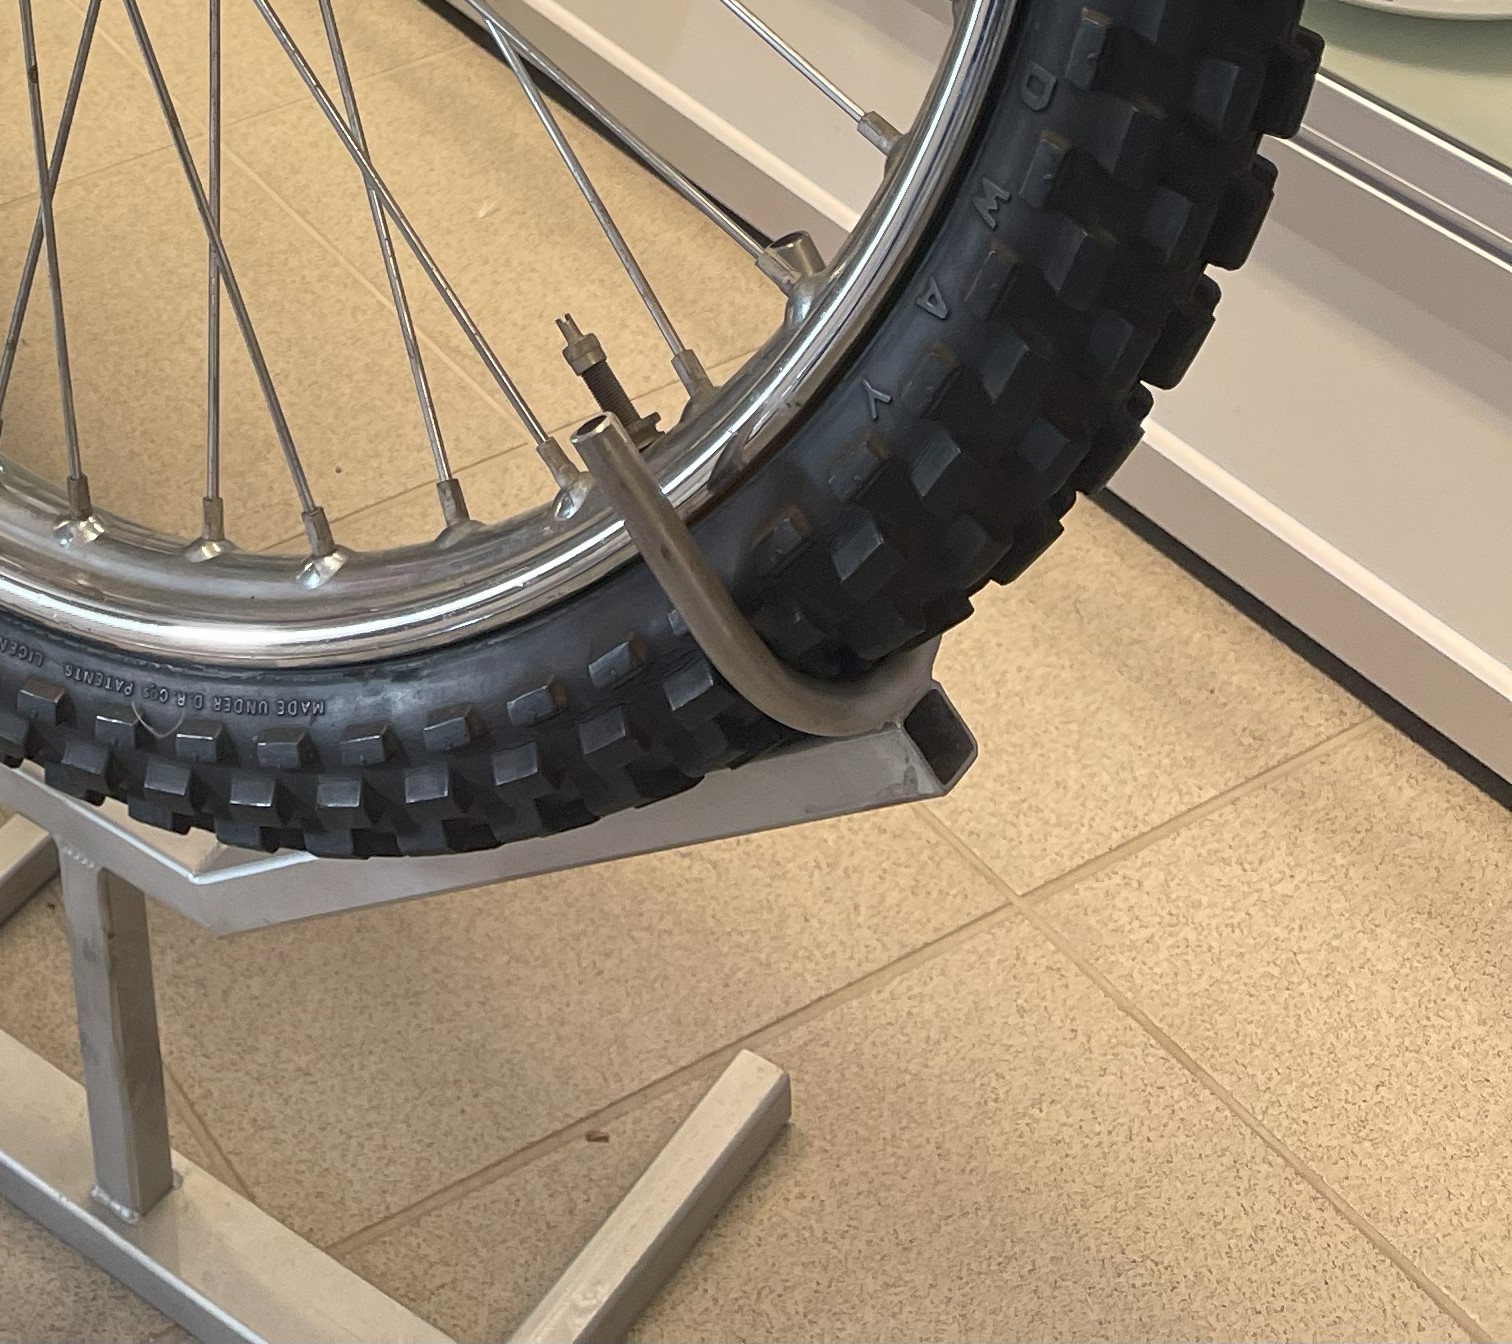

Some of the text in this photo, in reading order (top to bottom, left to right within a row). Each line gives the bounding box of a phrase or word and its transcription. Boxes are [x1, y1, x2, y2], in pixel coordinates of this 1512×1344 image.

[63, 663, 136, 697] PATENTS
[213, 696, 271, 716] UNDER
[278, 698, 326, 717] MADE
